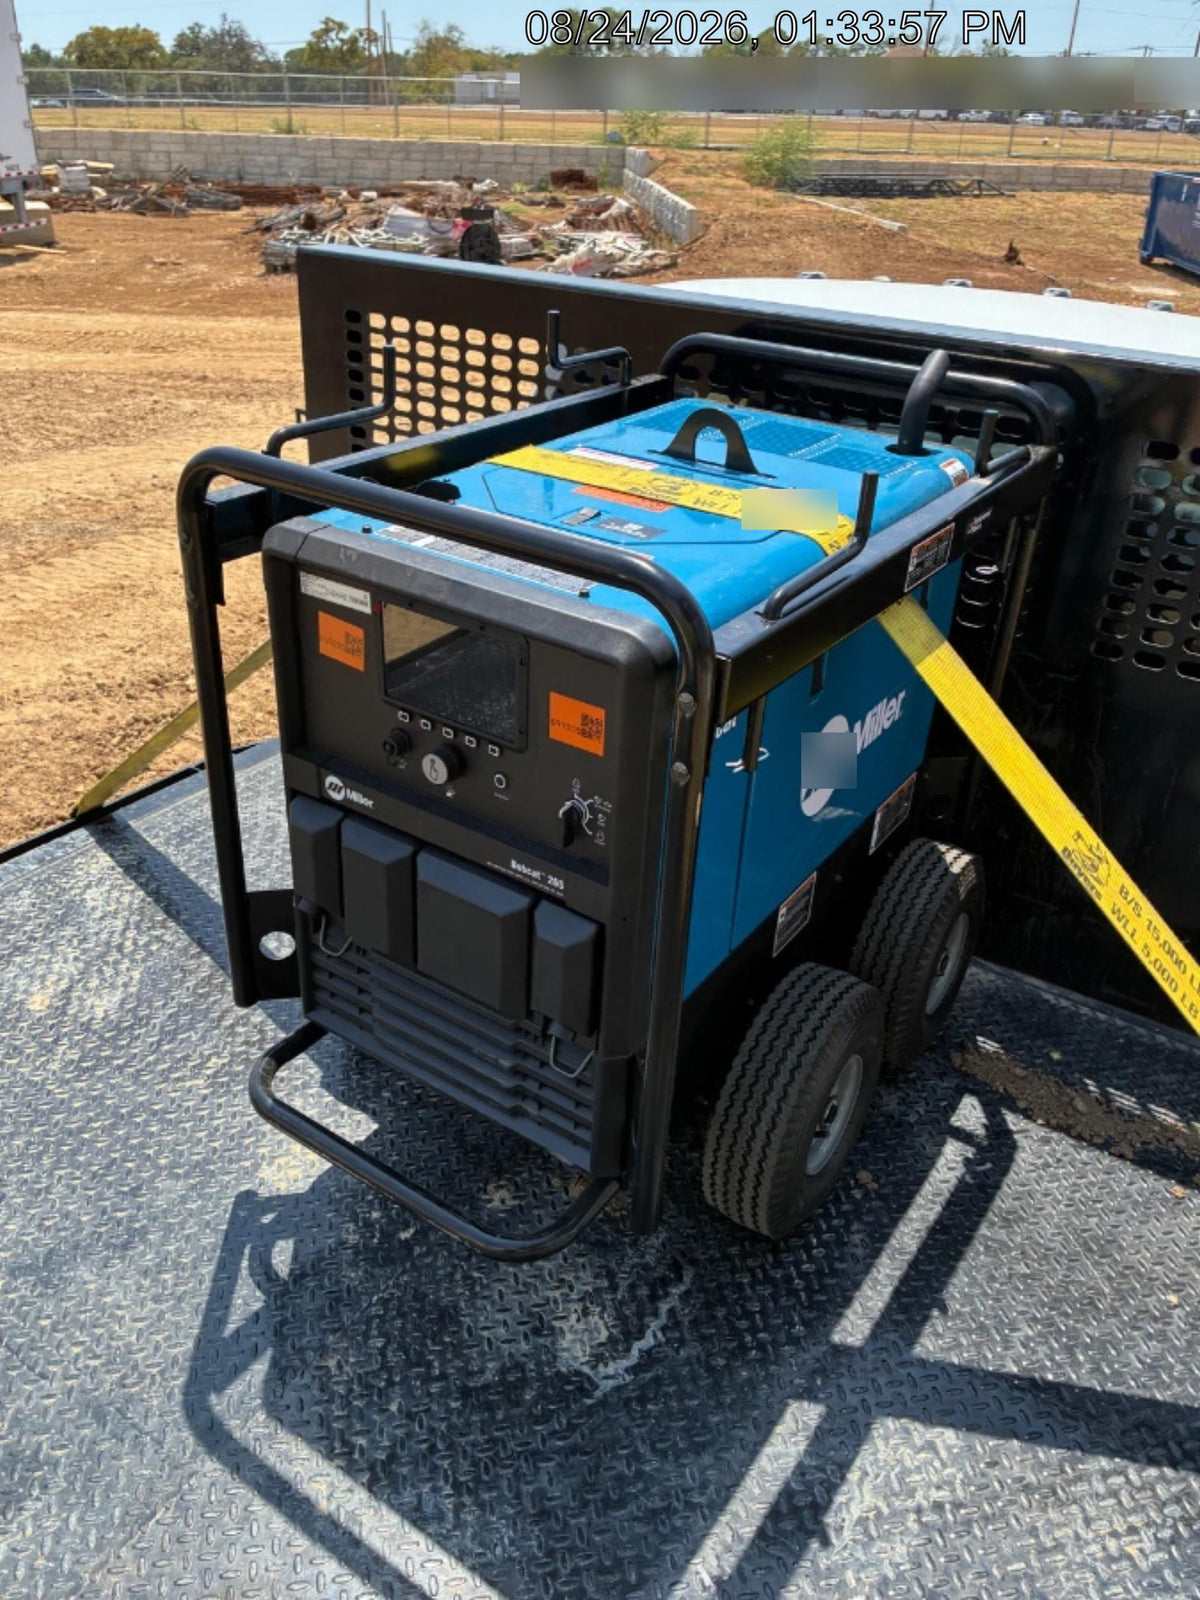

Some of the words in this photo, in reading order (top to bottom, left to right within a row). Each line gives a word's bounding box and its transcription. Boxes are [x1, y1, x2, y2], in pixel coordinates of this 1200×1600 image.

[853, 689, 906, 755] Miller
[1111, 901, 1138, 944] WLL
[1140, 943, 1179, 993] 5,000
[1119, 883, 1142, 918] B/S
[1146, 917, 1188, 975] 15,000
